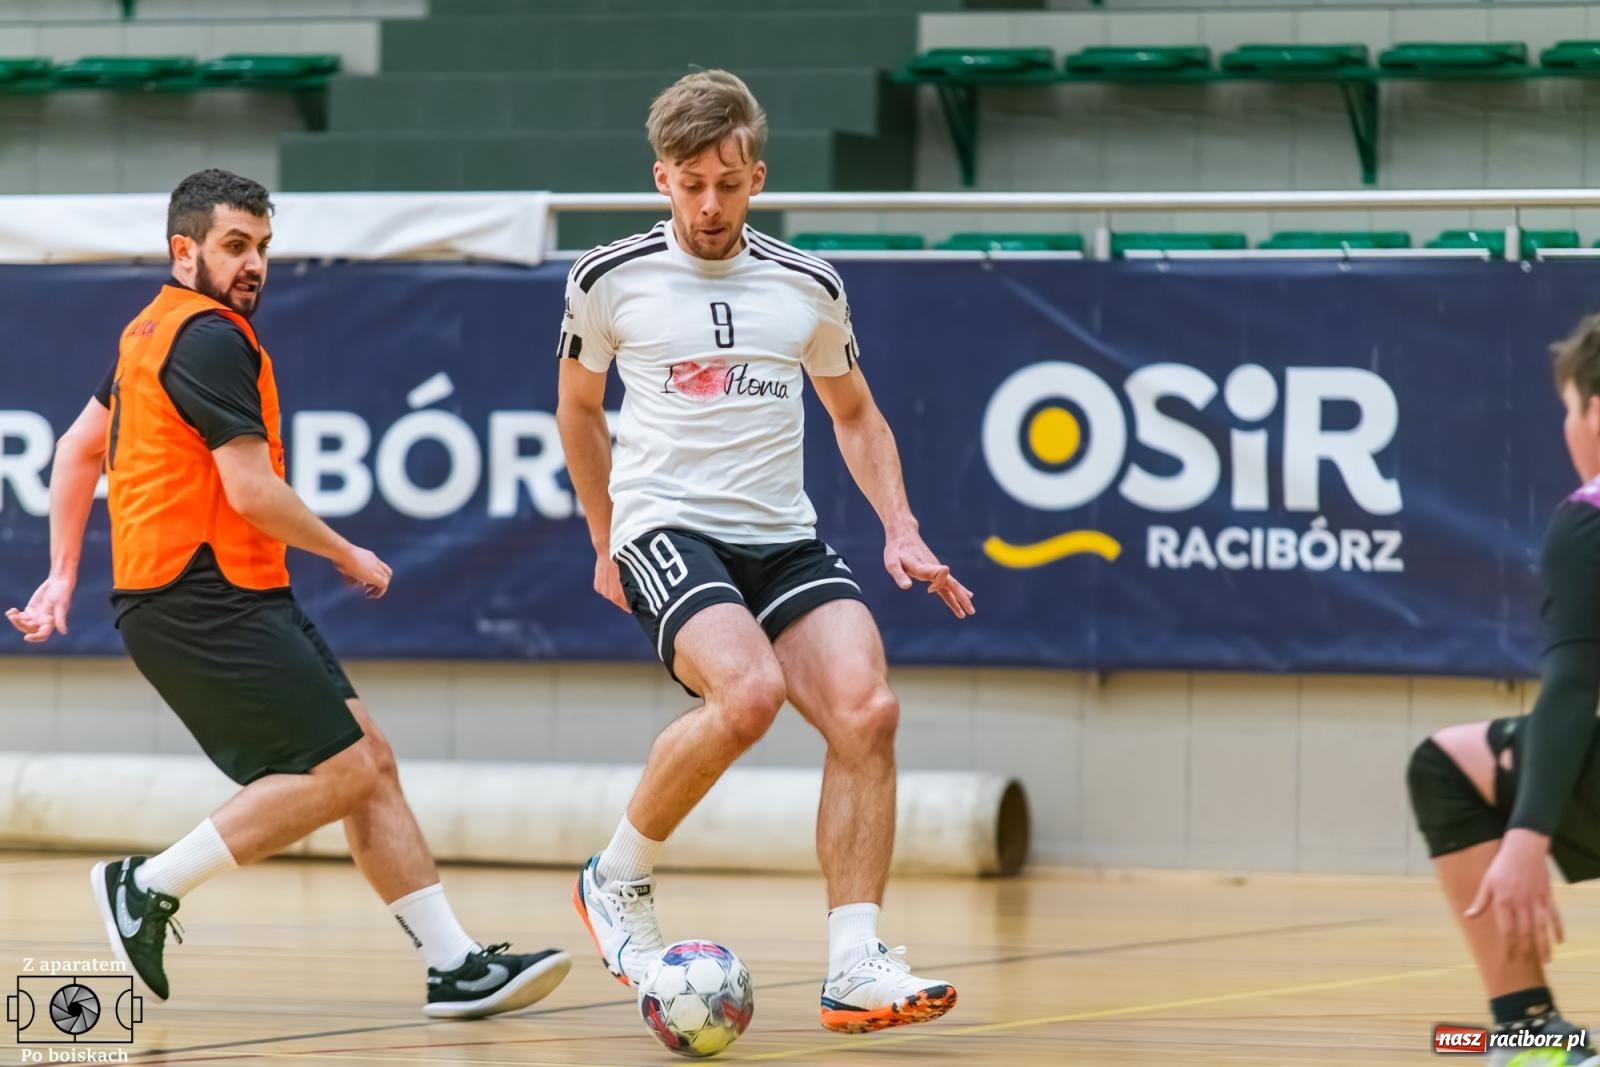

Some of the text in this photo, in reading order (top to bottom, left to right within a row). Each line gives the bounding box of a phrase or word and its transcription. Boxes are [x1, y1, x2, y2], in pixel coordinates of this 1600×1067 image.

[709, 301, 735, 349] 9
[981, 360, 1404, 516] OSiR
[649, 531, 689, 588] 9
[1146, 515, 1405, 573] RACIBÓRZ
